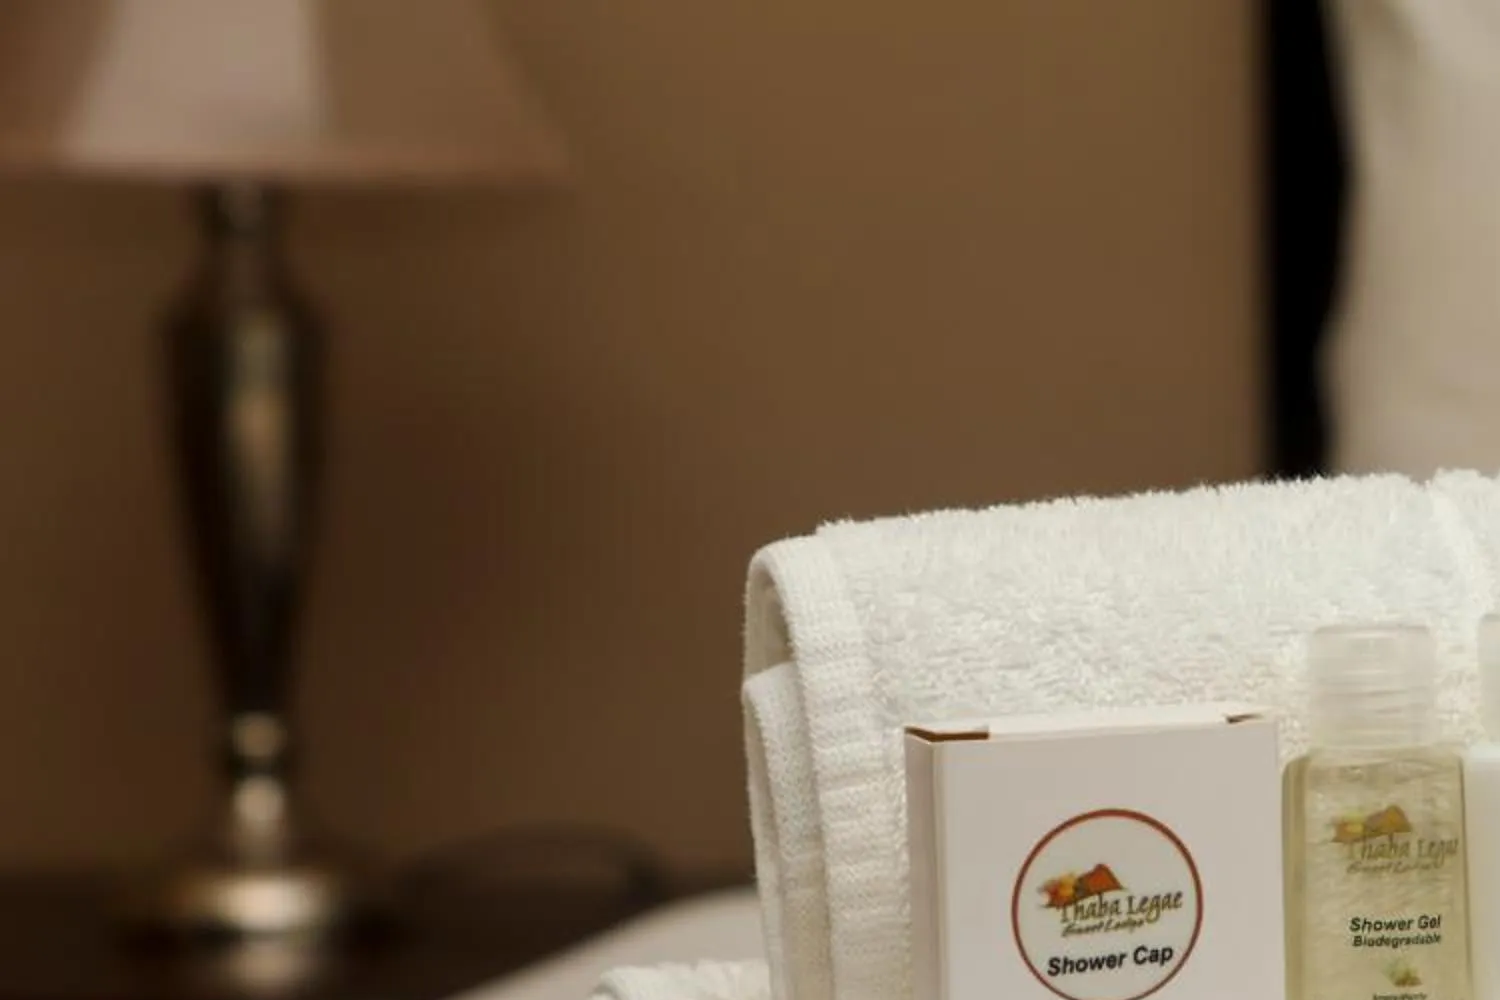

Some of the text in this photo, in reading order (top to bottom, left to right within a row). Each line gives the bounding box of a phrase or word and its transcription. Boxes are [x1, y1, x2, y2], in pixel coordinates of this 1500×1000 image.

[1126, 890, 1184, 924] Legae
[1349, 914, 1442, 933] Shower Gel
[1352, 932, 1442, 949] Biodegradable
[1047, 945, 1174, 977] Shower Cap
